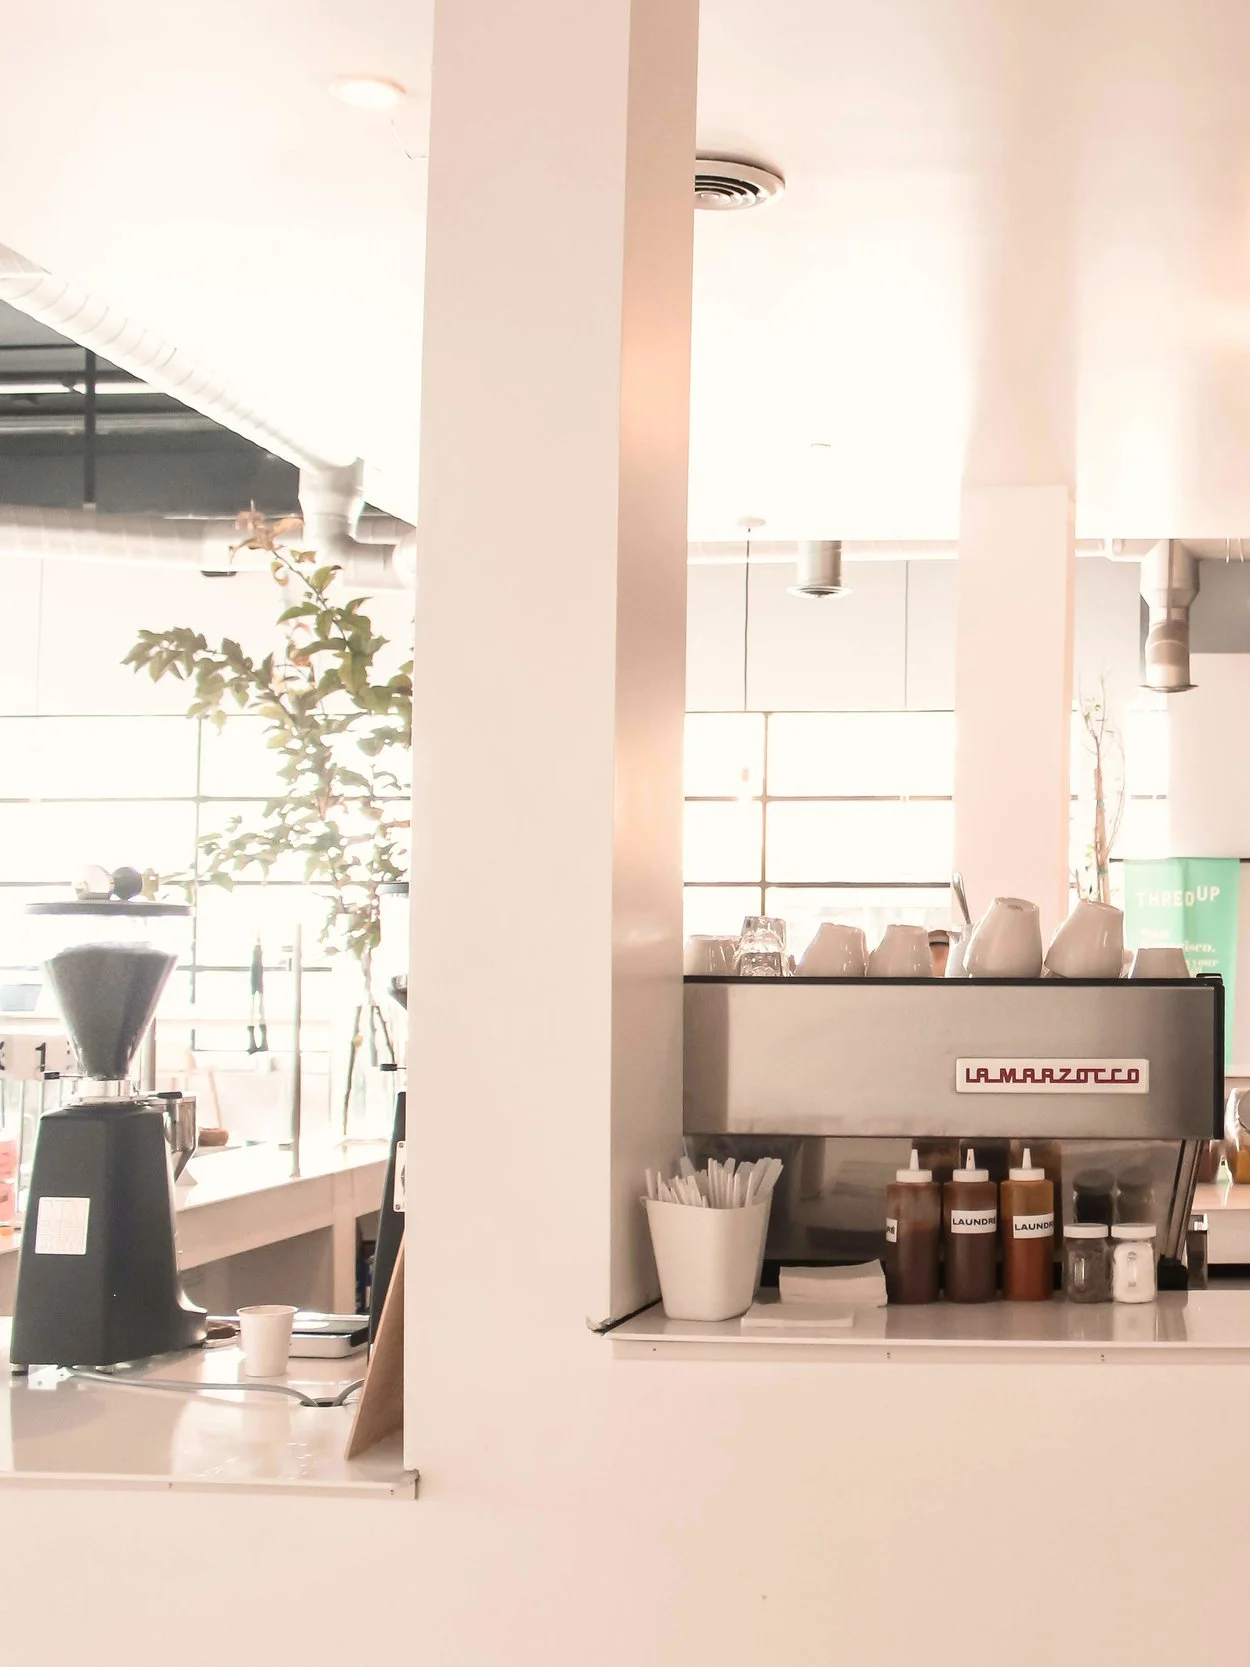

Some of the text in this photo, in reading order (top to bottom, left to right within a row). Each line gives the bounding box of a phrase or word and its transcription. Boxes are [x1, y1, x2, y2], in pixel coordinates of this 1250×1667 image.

[1136, 886, 1220, 907] THREDUP
[966, 1068, 1140, 1083] LA MARZOCCO
